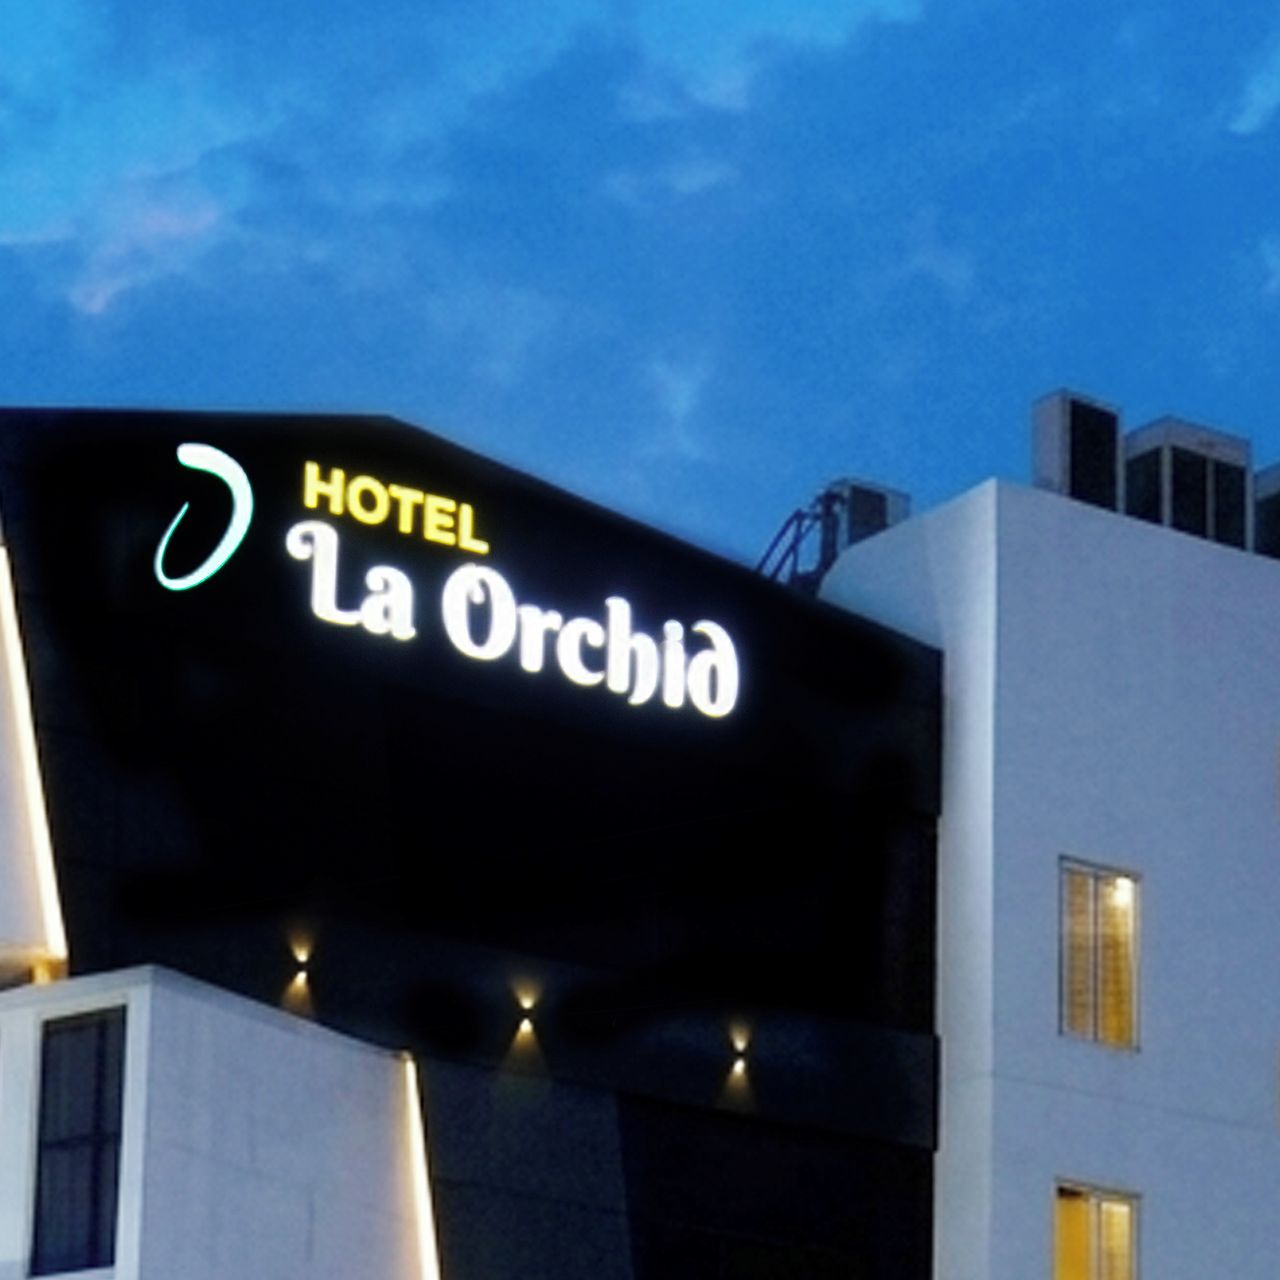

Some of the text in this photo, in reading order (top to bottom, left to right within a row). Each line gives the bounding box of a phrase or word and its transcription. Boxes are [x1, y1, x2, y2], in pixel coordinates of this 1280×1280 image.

[303, 460, 489, 554] HOTEL
[287, 520, 740, 717] La Orchid
